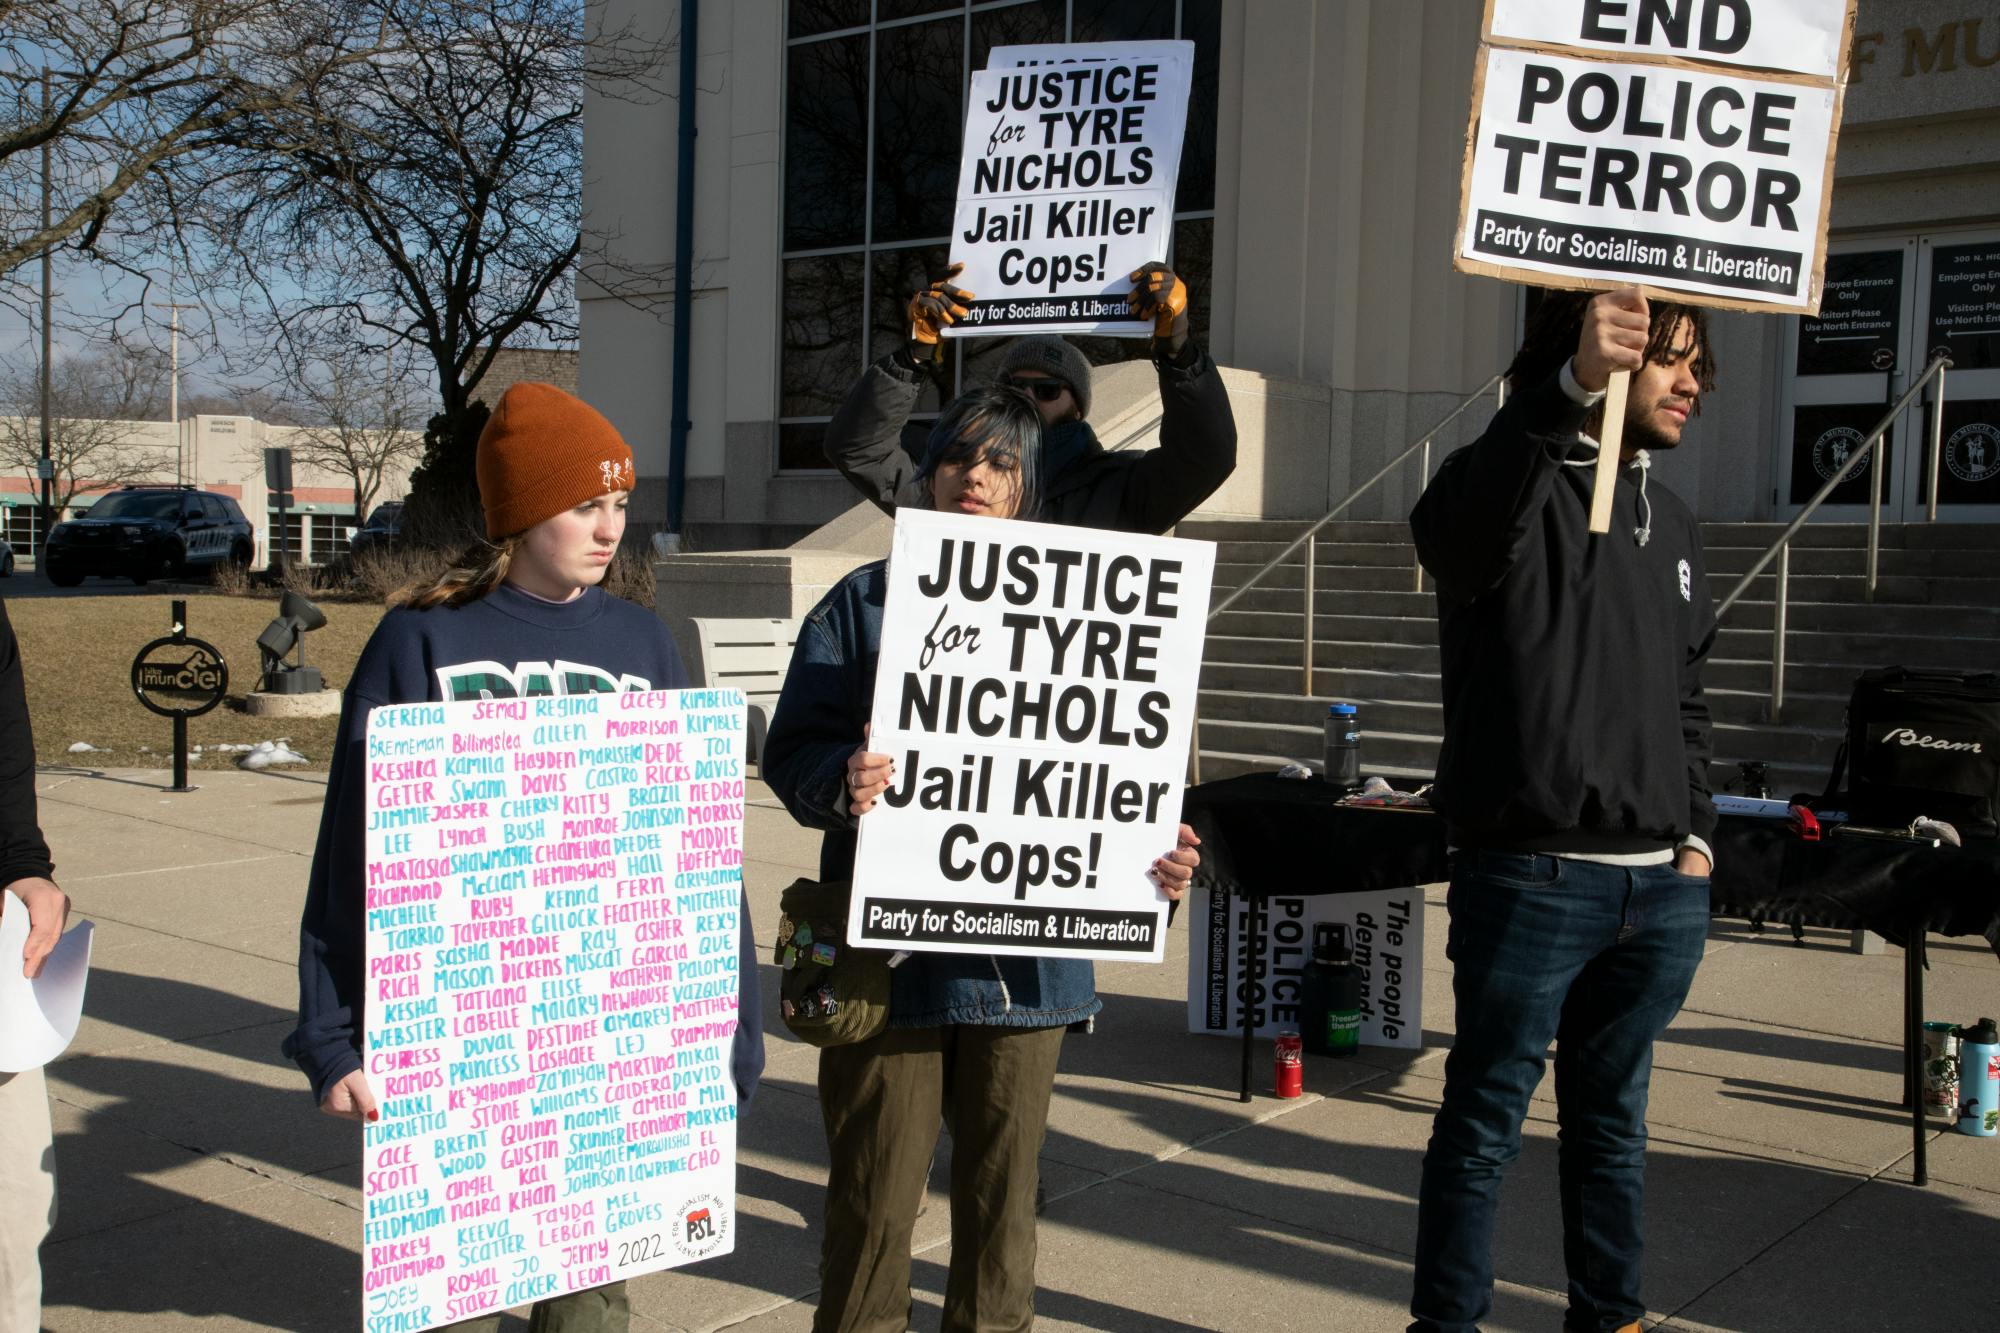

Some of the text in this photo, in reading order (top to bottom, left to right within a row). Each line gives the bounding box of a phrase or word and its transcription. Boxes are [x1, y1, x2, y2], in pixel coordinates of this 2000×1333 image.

[1580, 0, 1752, 54] END
[1848, 31, 1884, 84] F
[986, 64, 1159, 114] JUSTICE
[1516, 64, 1798, 157] POLICE
[987, 105, 1146, 157] for TYRE
[973, 146, 1153, 195] NICHOLS
[1493, 133, 1802, 233] TERROR
[963, 198, 1156, 244] Jail Killer
[1480, 219, 1793, 285] Party for Socialism & Liberation
[998, 243, 1108, 294] Cops!
[1938, 272, 1986, 283] Employee
[1823, 278, 1894, 290] ployee Entrance
[1839, 290, 1861, 301] Only
[1972, 282, 1996, 293] Only
[963, 298, 1131, 324] arty for Socialism & Liberati
[1852, 309, 1881, 319] Please
[1935, 317, 1953, 326] Use
[1955, 315, 1983, 324] North
[1947, 303, 1984, 313] Visitors
[1805, 320, 1892, 333] Use North Entrance
[917, 538, 1184, 620] JUSTICE
[919, 603, 1164, 684] for TYRE
[687, 713, 742, 734] KIMBLE
[898, 671, 1172, 750] NICHOLS
[645, 742, 684, 764] DEDE
[704, 737, 731, 757] TOI
[1881, 728, 1982, 754] Beam
[646, 765, 691, 785] RICKS
[883, 749, 1170, 826] Jail Killer
[377, 781, 435, 808] GETER
[368, 806, 430, 831] JIMMIE
[687, 803, 743, 826] MORRIS
[385, 833, 412, 855] LEE
[503, 818, 545, 844] BUSH
[938, 823, 1103, 901] Cops!
[868, 904, 1151, 943] Party for Socialism & Liberation
[699, 934, 733, 955] QUE
[1211, 890, 1227, 1027] arty for Socialism & Liberation
[1272, 898, 1304, 1024] POLICE
[1378, 900, 1410, 1042] The people
[378, 974, 420, 1001] RICH
[368, 1017, 447, 1050] WEBSTER
[615, 1033, 645, 1056] LEJ
[382, 1094, 432, 1120] NIKKI
[700, 1130, 718, 1147] EL
[438, 1152, 486, 1179] WOOD
[687, 1148, 720, 1172] CHO
[366, 1163, 420, 1197] SCOTT
[606, 1191, 641, 1211] MEL
[677, 1193, 711, 1218] SOCIALISM
[605, 1202, 663, 1233] GROVES
[686, 1216, 717, 1243] PSL
[617, 1233, 665, 1268] 2022
[512, 1256, 540, 1278] JO
